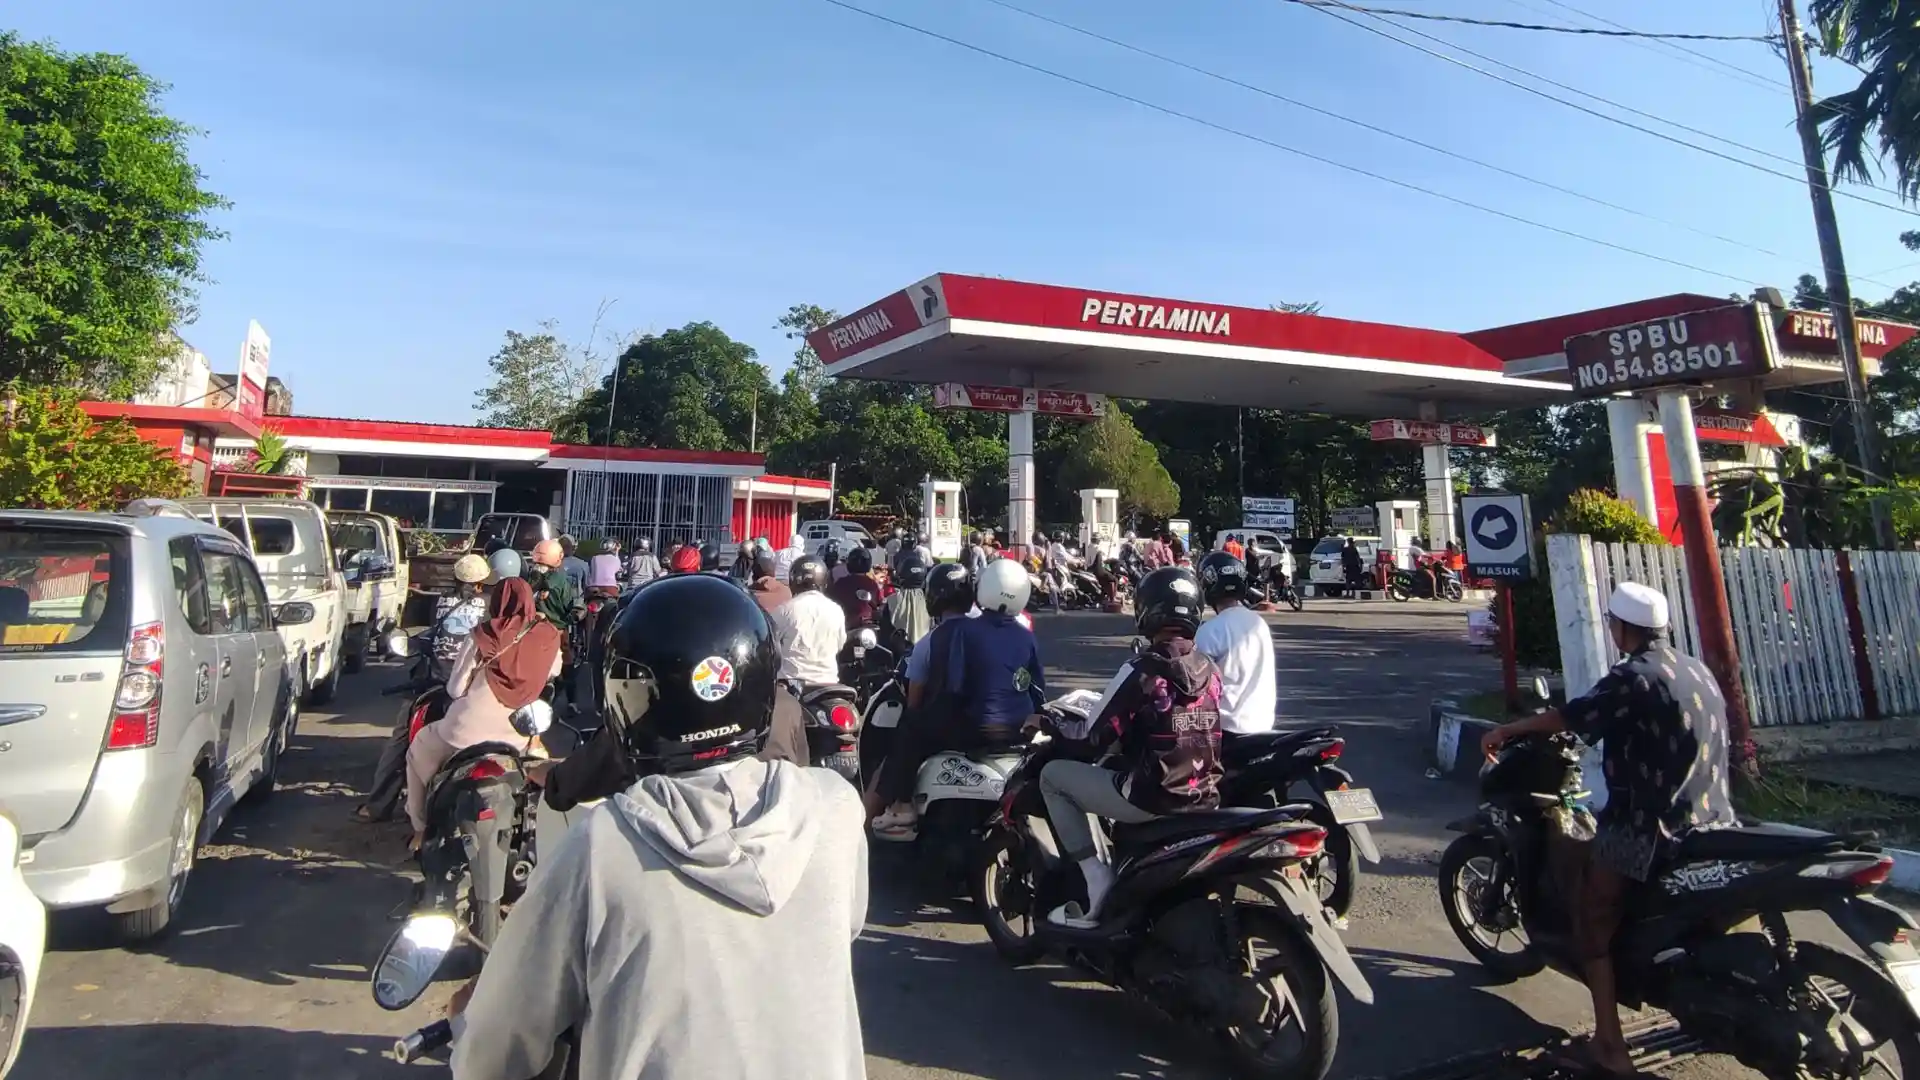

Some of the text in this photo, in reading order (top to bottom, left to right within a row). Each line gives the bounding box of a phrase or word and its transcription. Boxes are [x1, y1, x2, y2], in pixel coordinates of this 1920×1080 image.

[827, 308, 894, 351] PERTAMINA
[1081, 297, 1232, 337] PERTAMINA
[1793, 314, 1887, 345] PERTINA
[1608, 317, 1689, 356] SPBU
[1577, 341, 1743, 389] NO.54.83501
[975, 392, 1018, 402] PERTALITE
[1043, 397, 1084, 407] PERTALITE
[1648, 411, 1655, 422] 3
[1476, 566, 1520, 576] MASUK
[680, 723, 742, 743] HONDA
